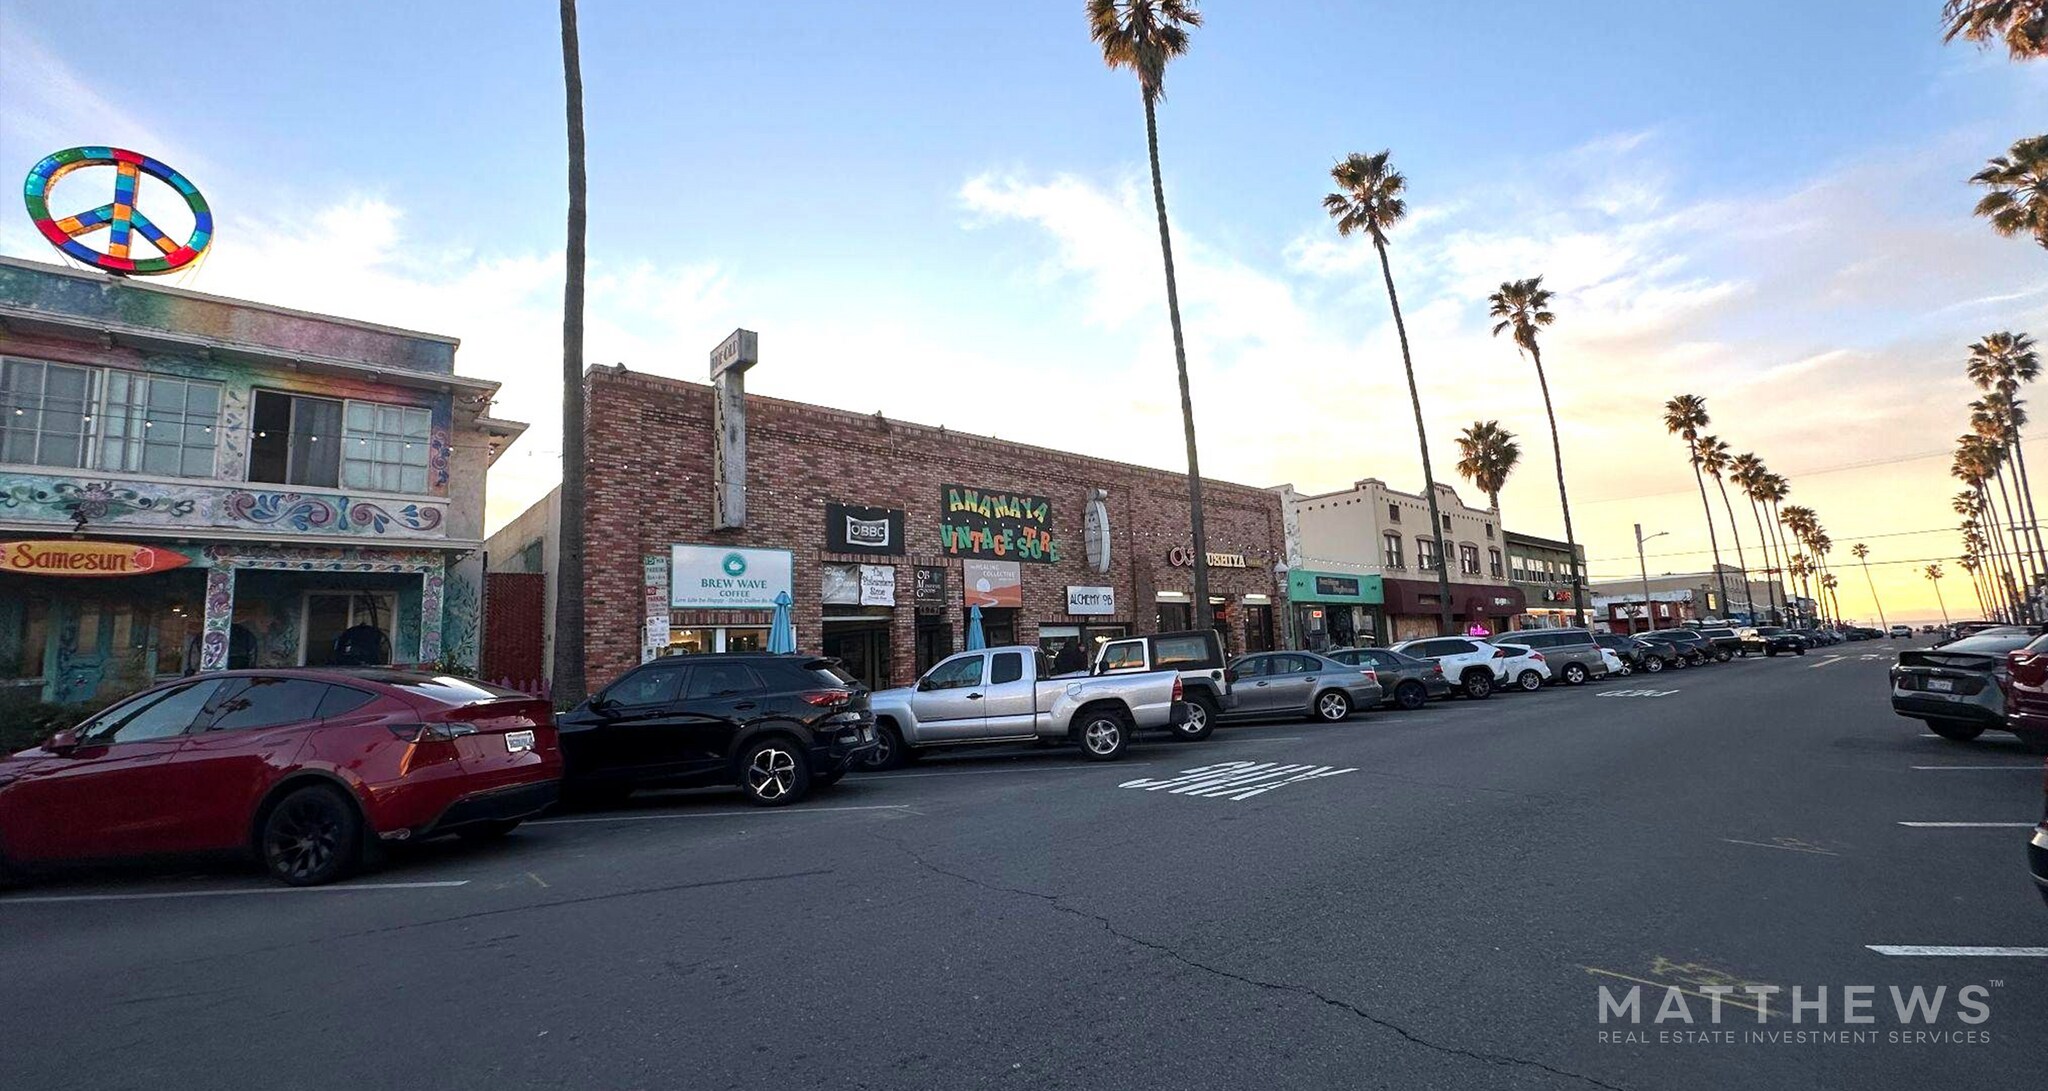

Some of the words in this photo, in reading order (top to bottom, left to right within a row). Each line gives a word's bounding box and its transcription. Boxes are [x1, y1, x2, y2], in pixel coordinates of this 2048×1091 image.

[949, 488, 1048, 524] ANAMAYA
[851, 524, 884, 537] OBBC
[939, 522, 1014, 556] VINTAGE
[1017, 526, 1060, 562] STORE
[11, 543, 126, 571] Samesun
[917, 570, 930, 580] OB
[701, 578, 733, 589] BREW
[737, 579, 767, 589] WAVE
[719, 590, 750, 598] COFFEE
[1069, 594, 1100, 606] ALCHEMY
